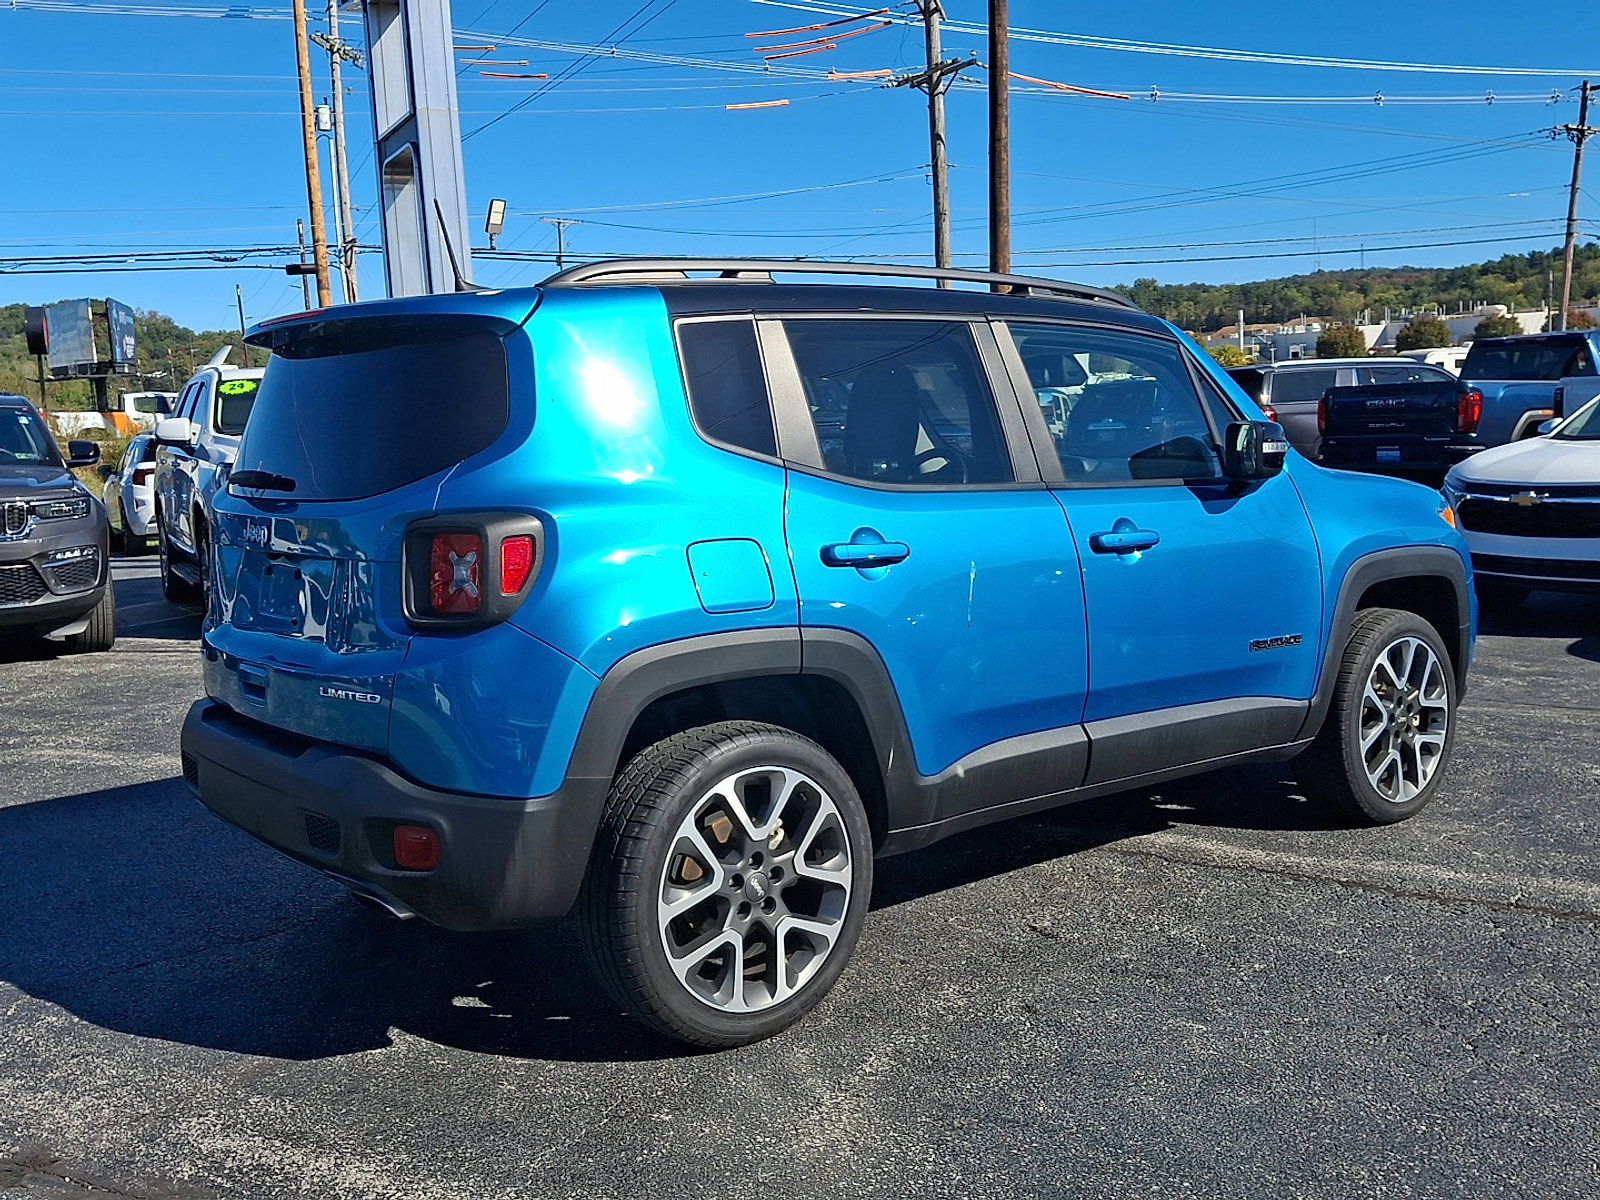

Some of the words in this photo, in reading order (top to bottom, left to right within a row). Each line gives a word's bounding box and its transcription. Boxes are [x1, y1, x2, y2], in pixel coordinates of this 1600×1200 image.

[243, 518, 268, 548] Jeep
[1249, 633, 1303, 652] RENEGADE
[319, 686, 382, 704] LIMITED
